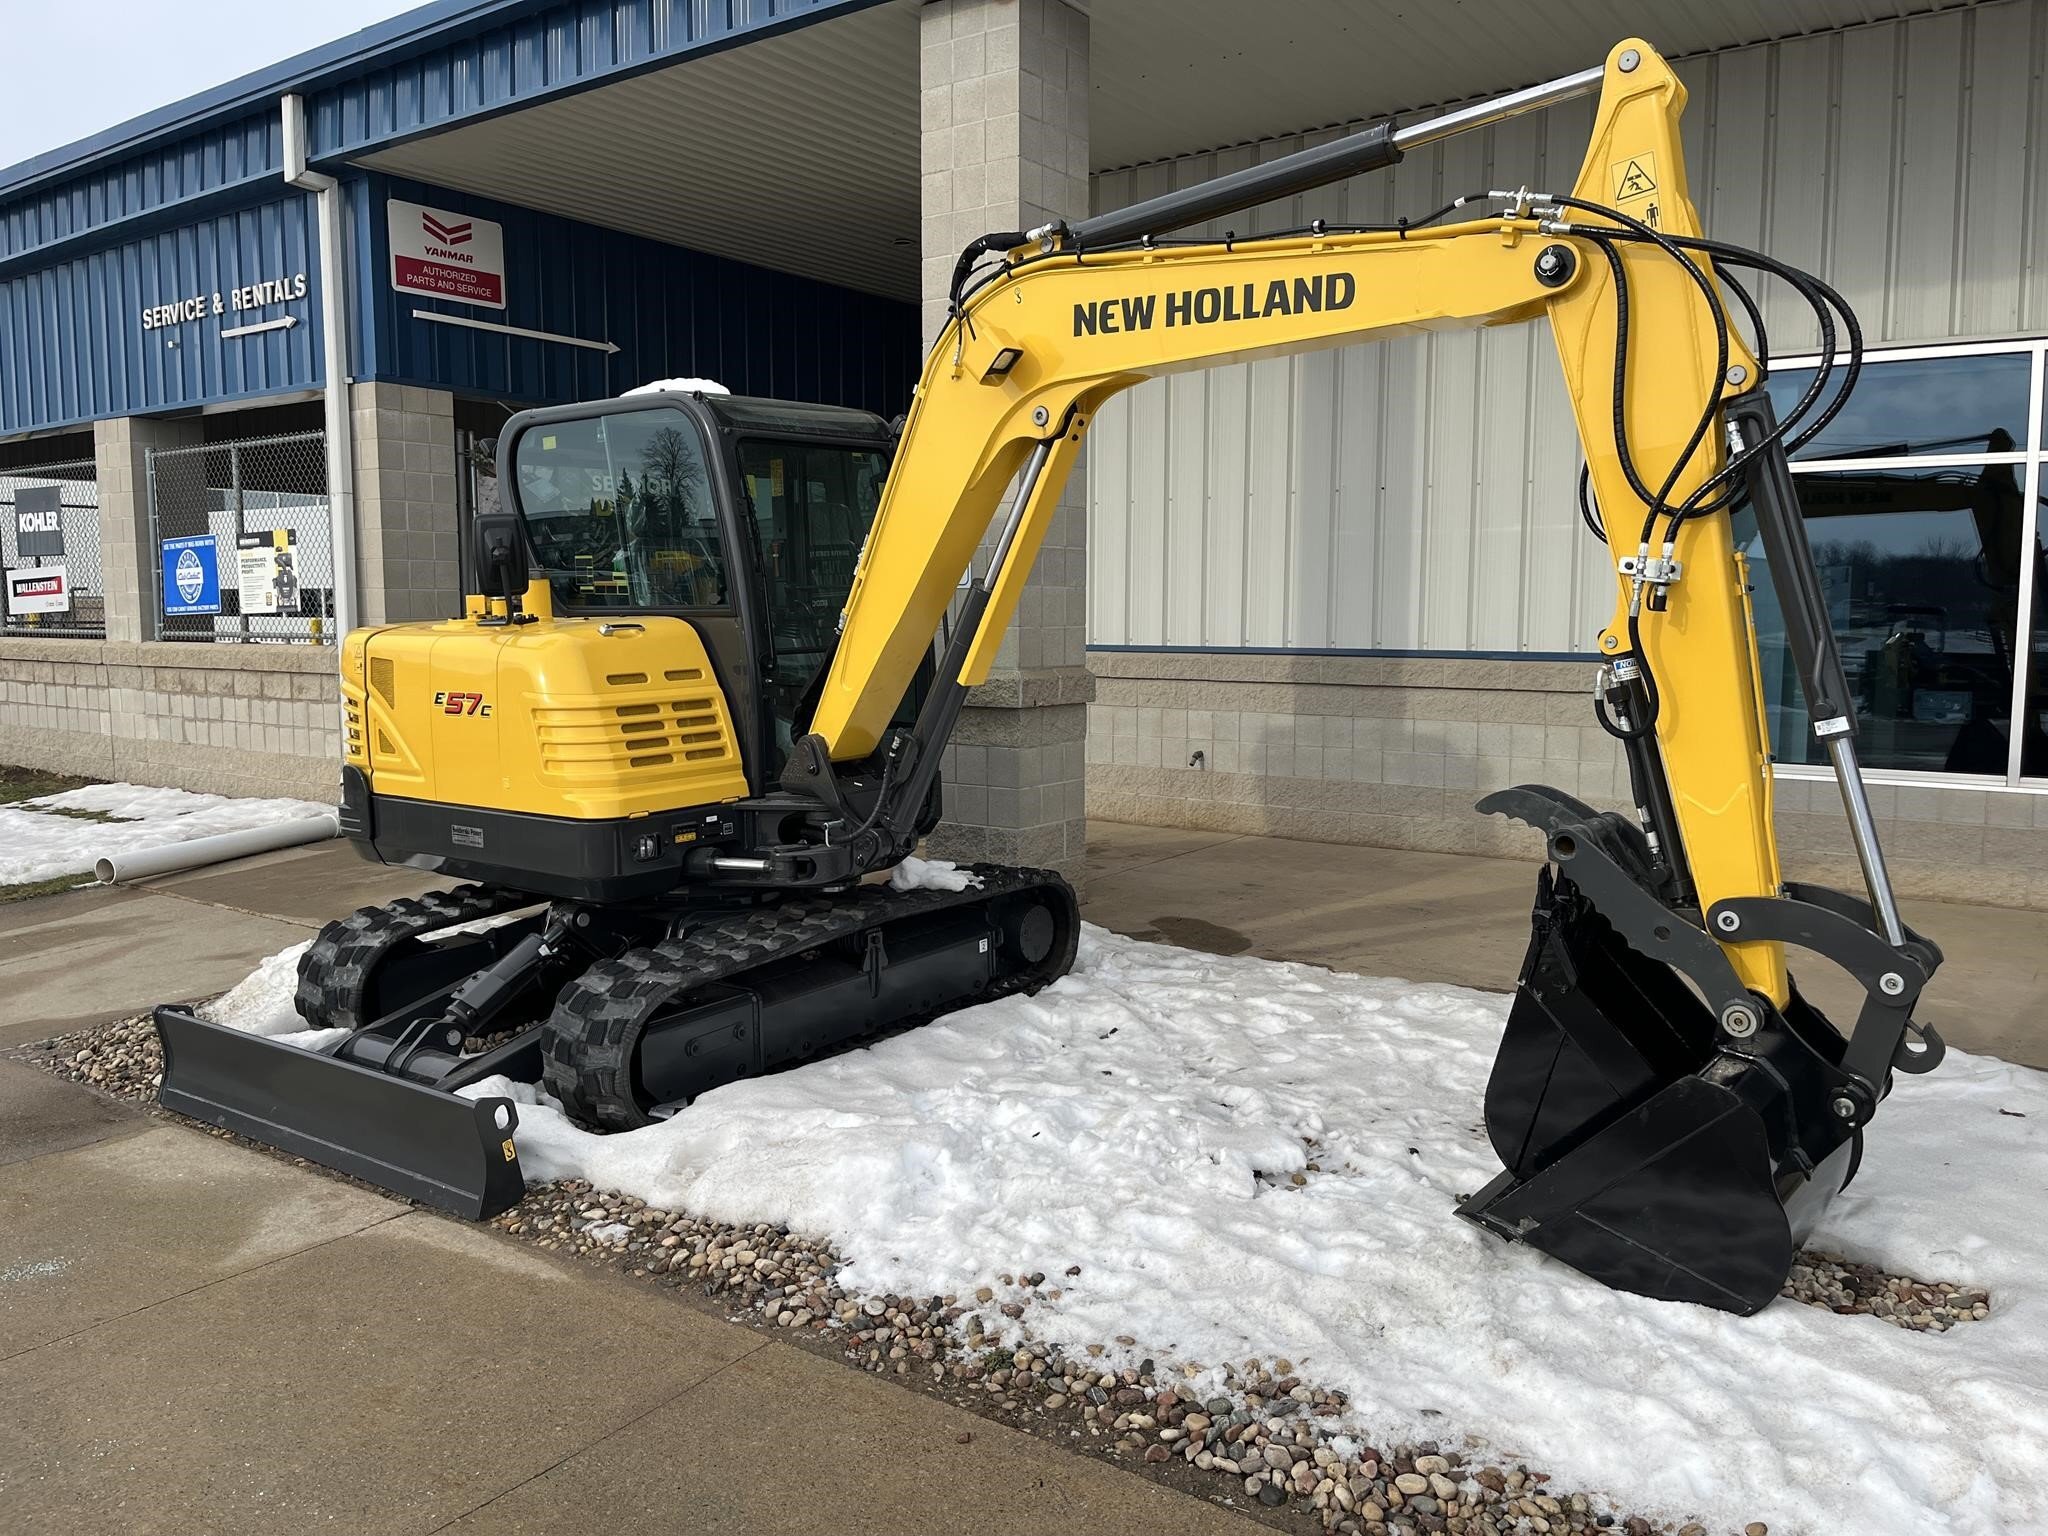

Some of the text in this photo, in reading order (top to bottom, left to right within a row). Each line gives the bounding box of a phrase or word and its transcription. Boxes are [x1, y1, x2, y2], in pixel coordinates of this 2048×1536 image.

[424, 246, 473, 263] YANMAR
[422, 265, 477, 283] AUTHORIZED
[406, 274, 492, 297] PARTS AND SERVICE
[142, 273, 307, 330] SERVICE & RENTALS
[1073, 272, 1356, 337] NEW HOLLAND
[18, 511, 58, 532] KOHLER
[15, 580, 58, 594] WALLENSTEIN
